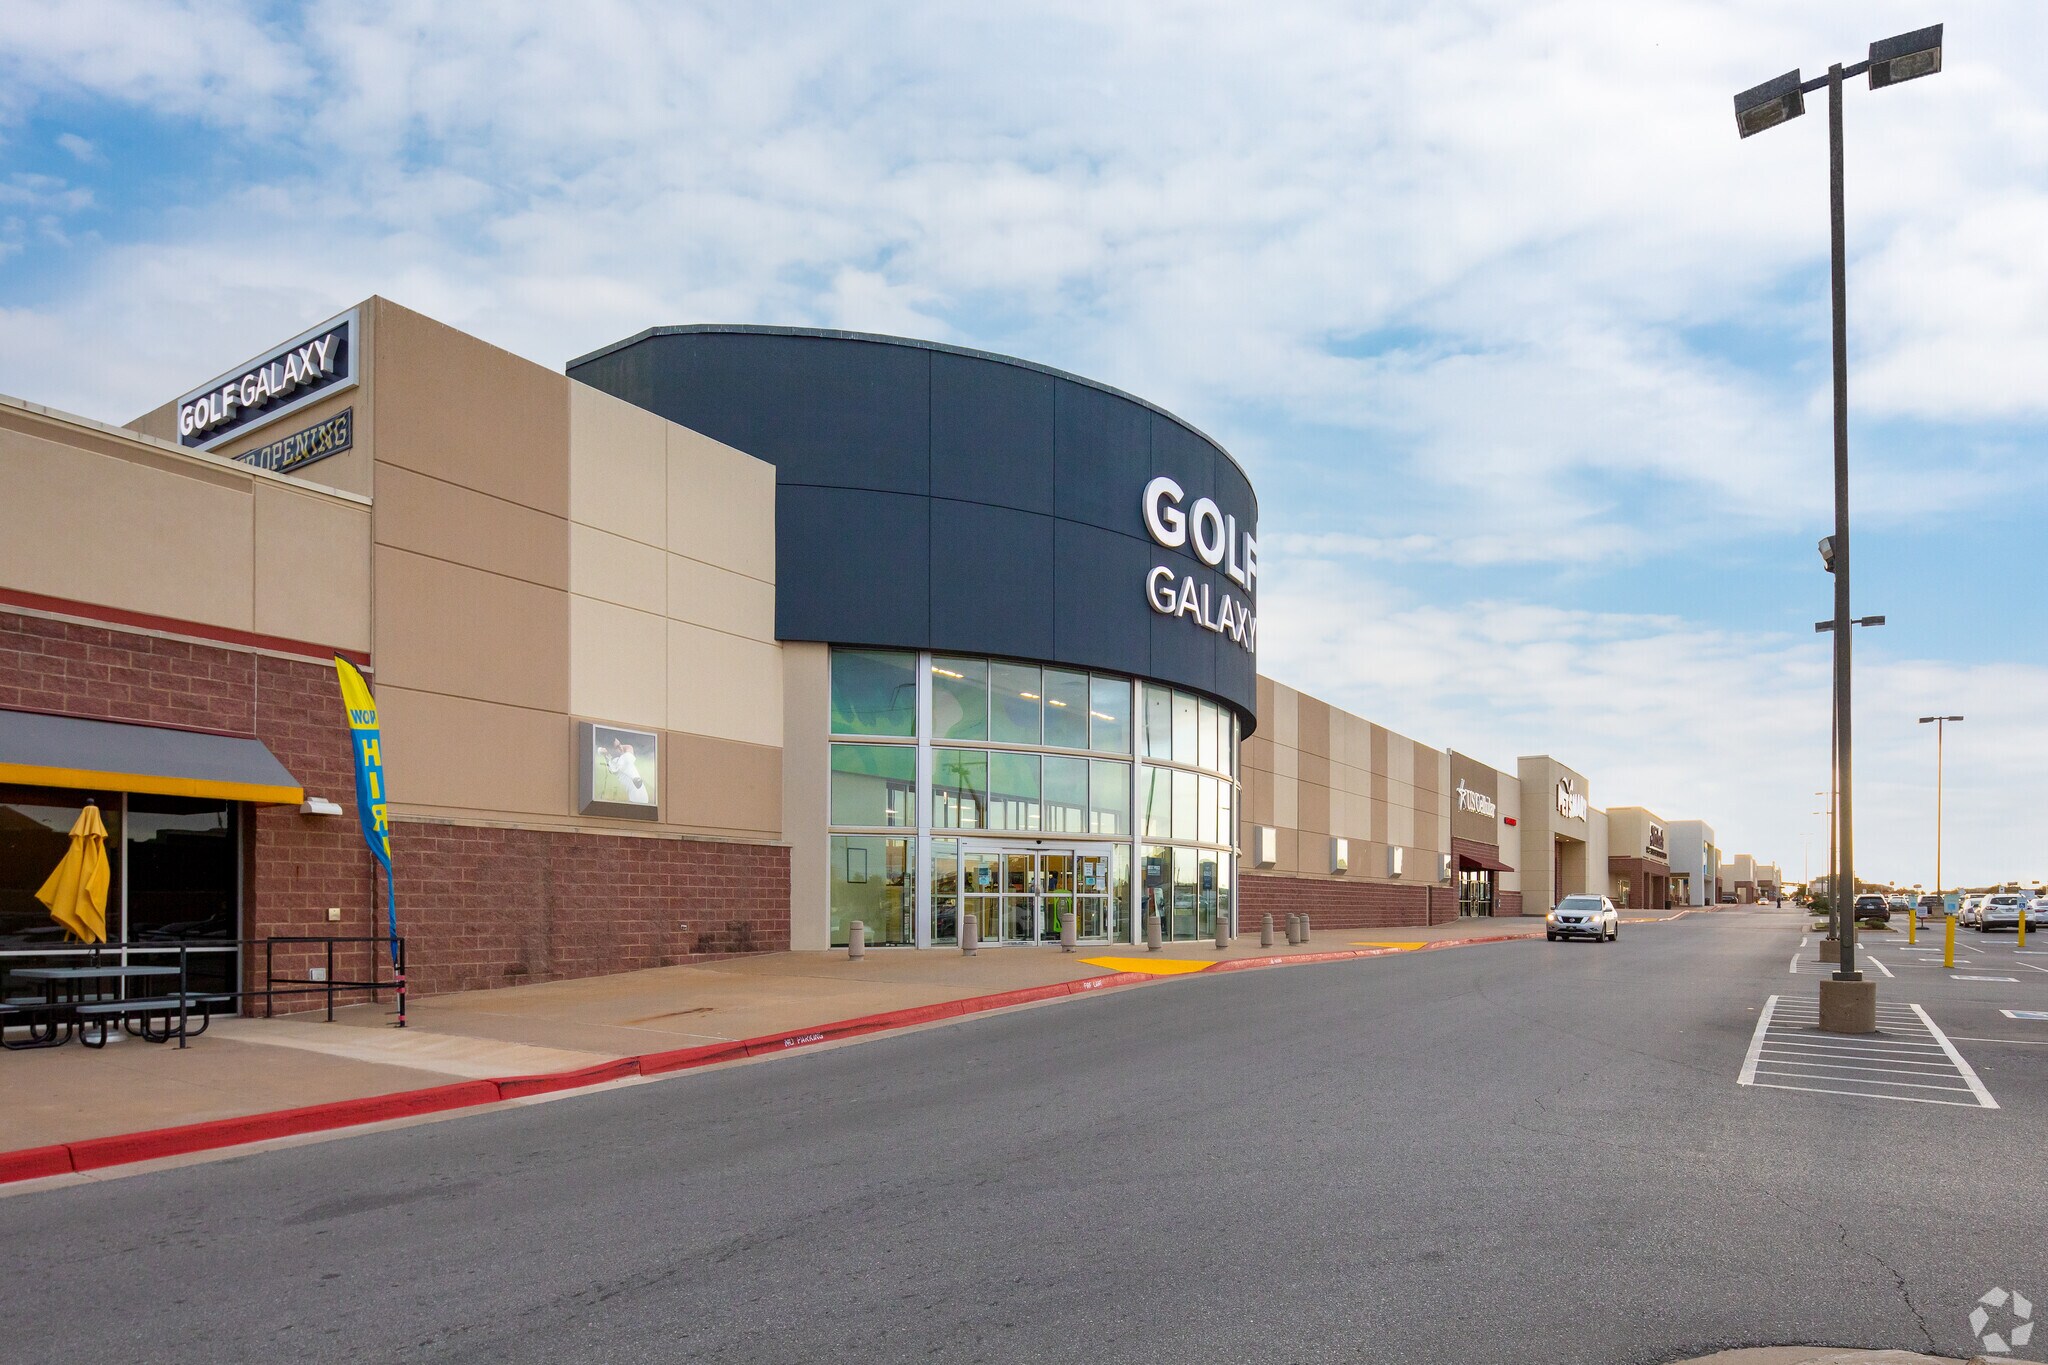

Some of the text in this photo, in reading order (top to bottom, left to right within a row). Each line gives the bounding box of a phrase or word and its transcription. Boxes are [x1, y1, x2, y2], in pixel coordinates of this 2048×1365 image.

[180, 333, 341, 437] GOLF GALAXY
[260, 416, 347, 470] OPENING
[1142, 476, 1257, 592] GOLF
[1145, 565, 1257, 653] GALAXY
